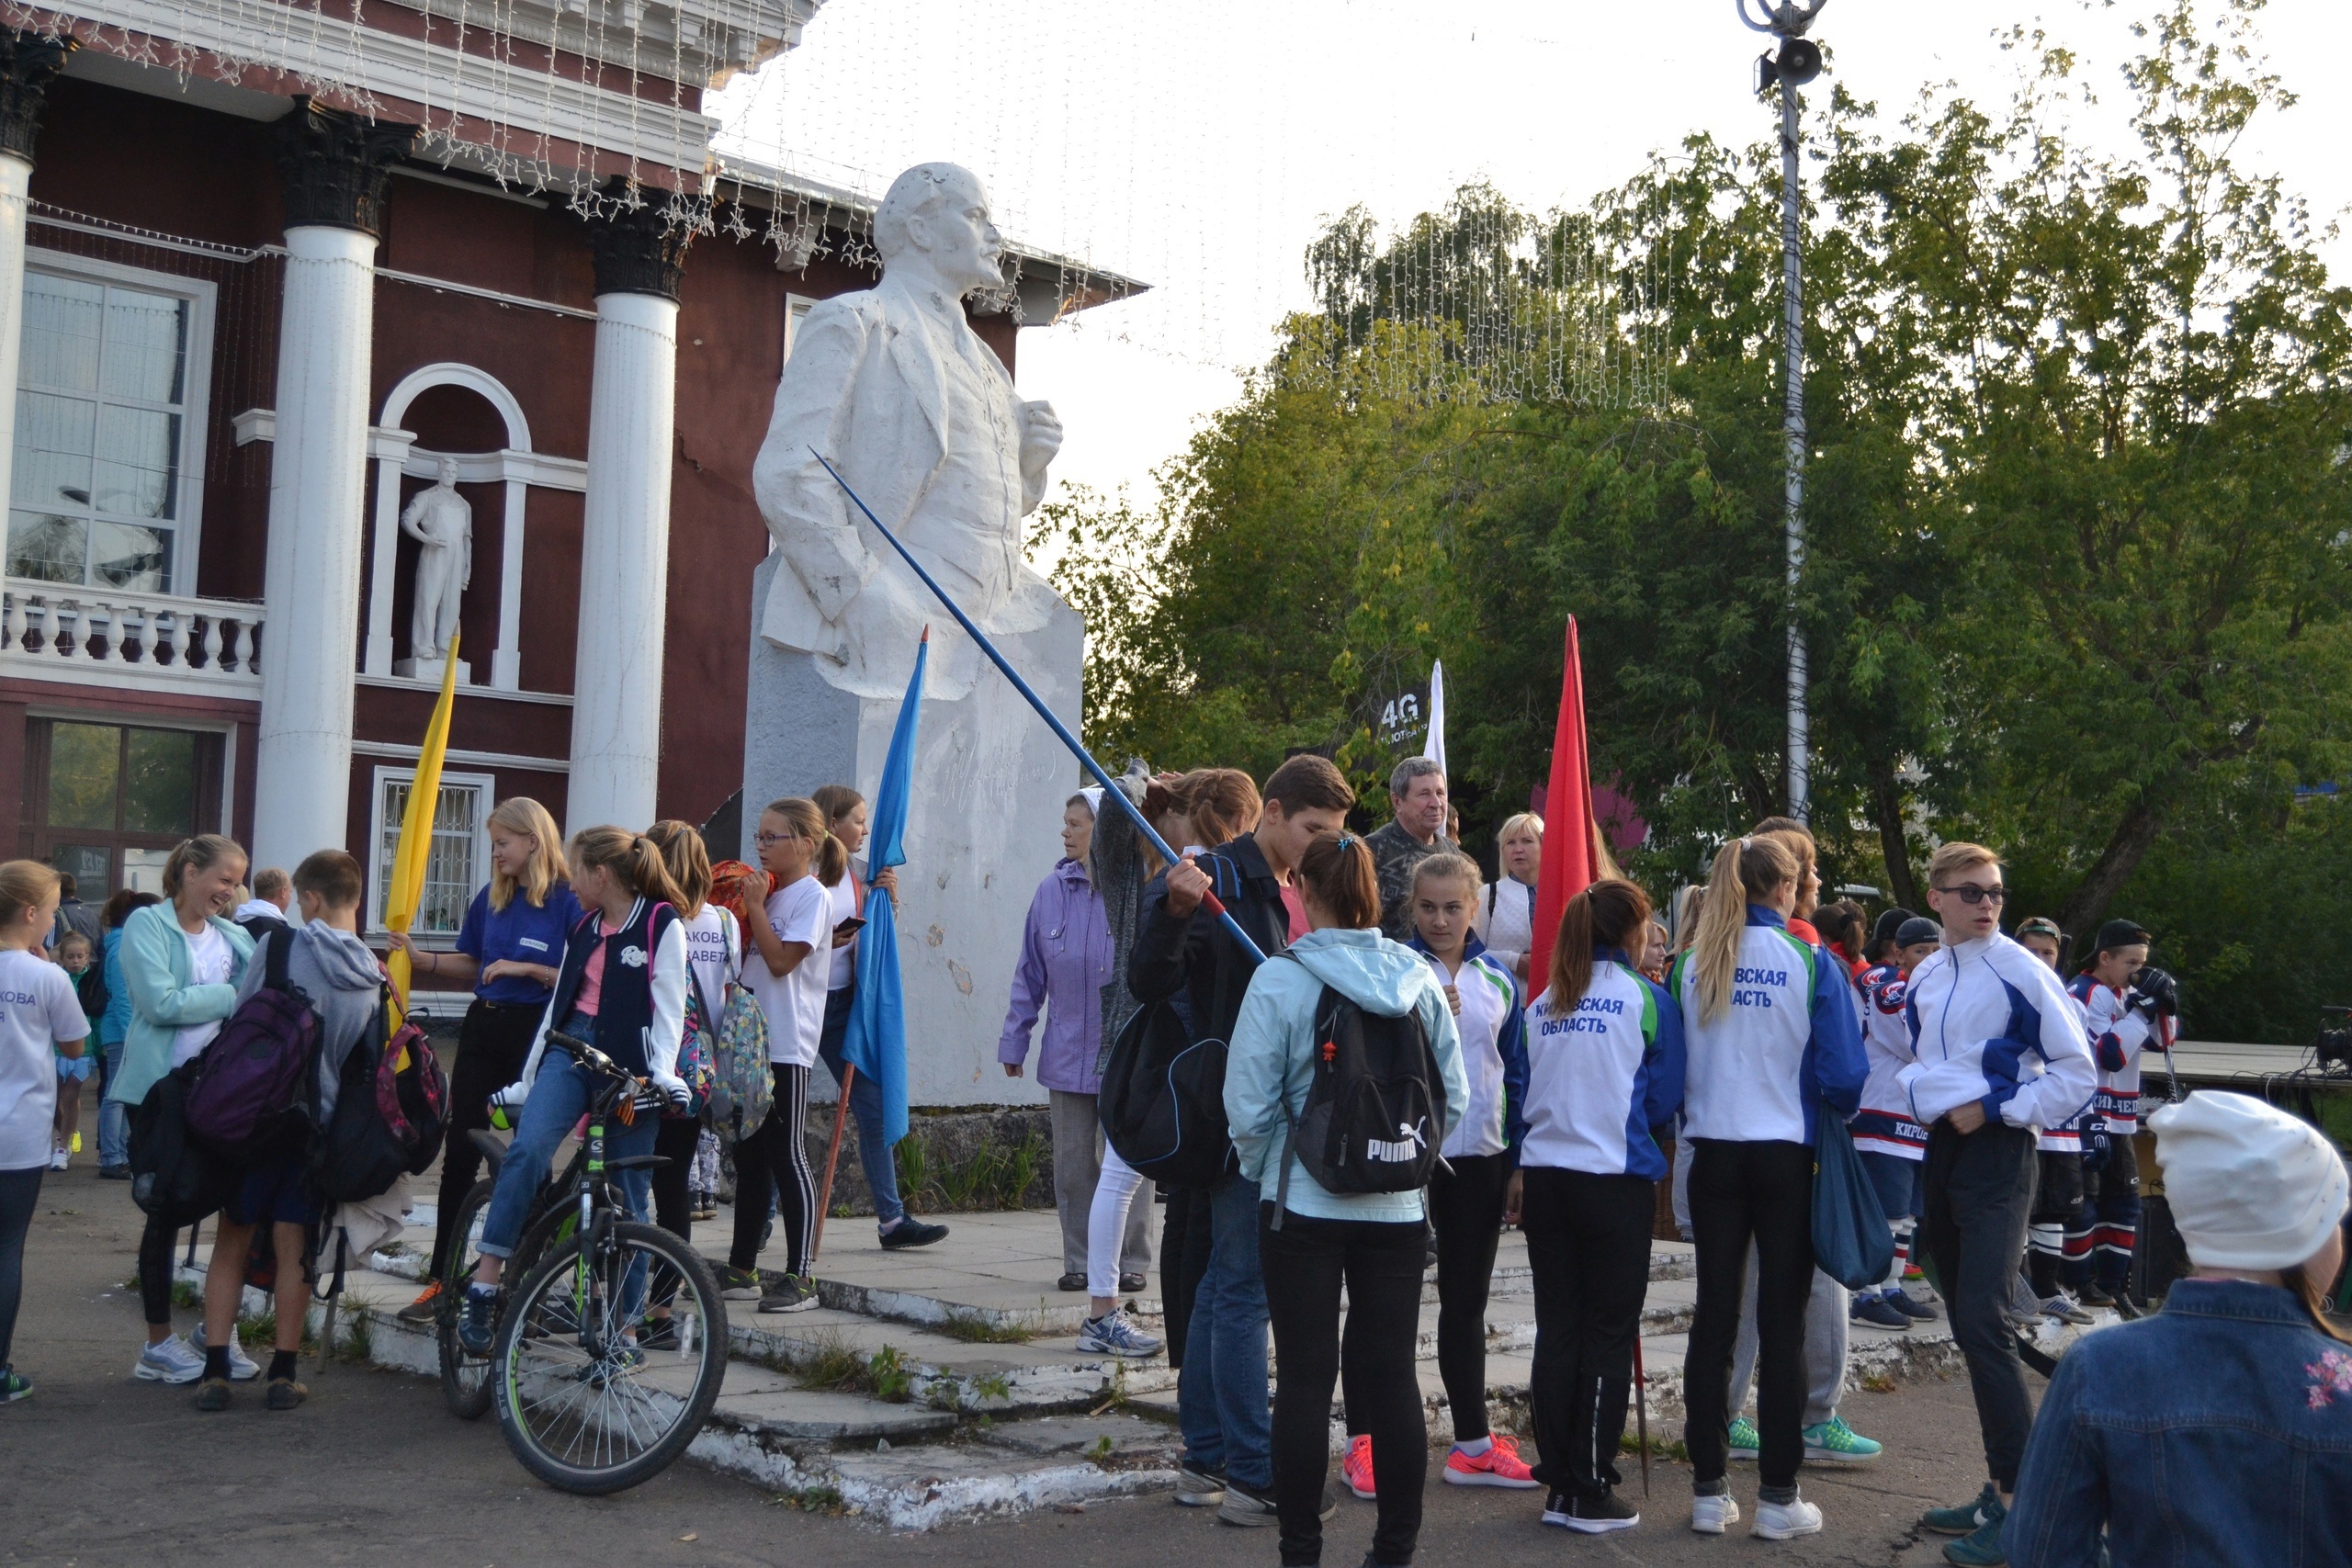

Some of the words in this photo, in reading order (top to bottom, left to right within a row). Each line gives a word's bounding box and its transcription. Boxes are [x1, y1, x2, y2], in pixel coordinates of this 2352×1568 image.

[1381, 694, 1419, 728] 4G
[1535, 998, 1624, 1018] КИВСКАЯ
[1542, 1017, 1607, 1036] ОБЛАСТЬ
[1367, 1138, 1417, 1162] PUMA
[497, 1359, 510, 1419] STELS
